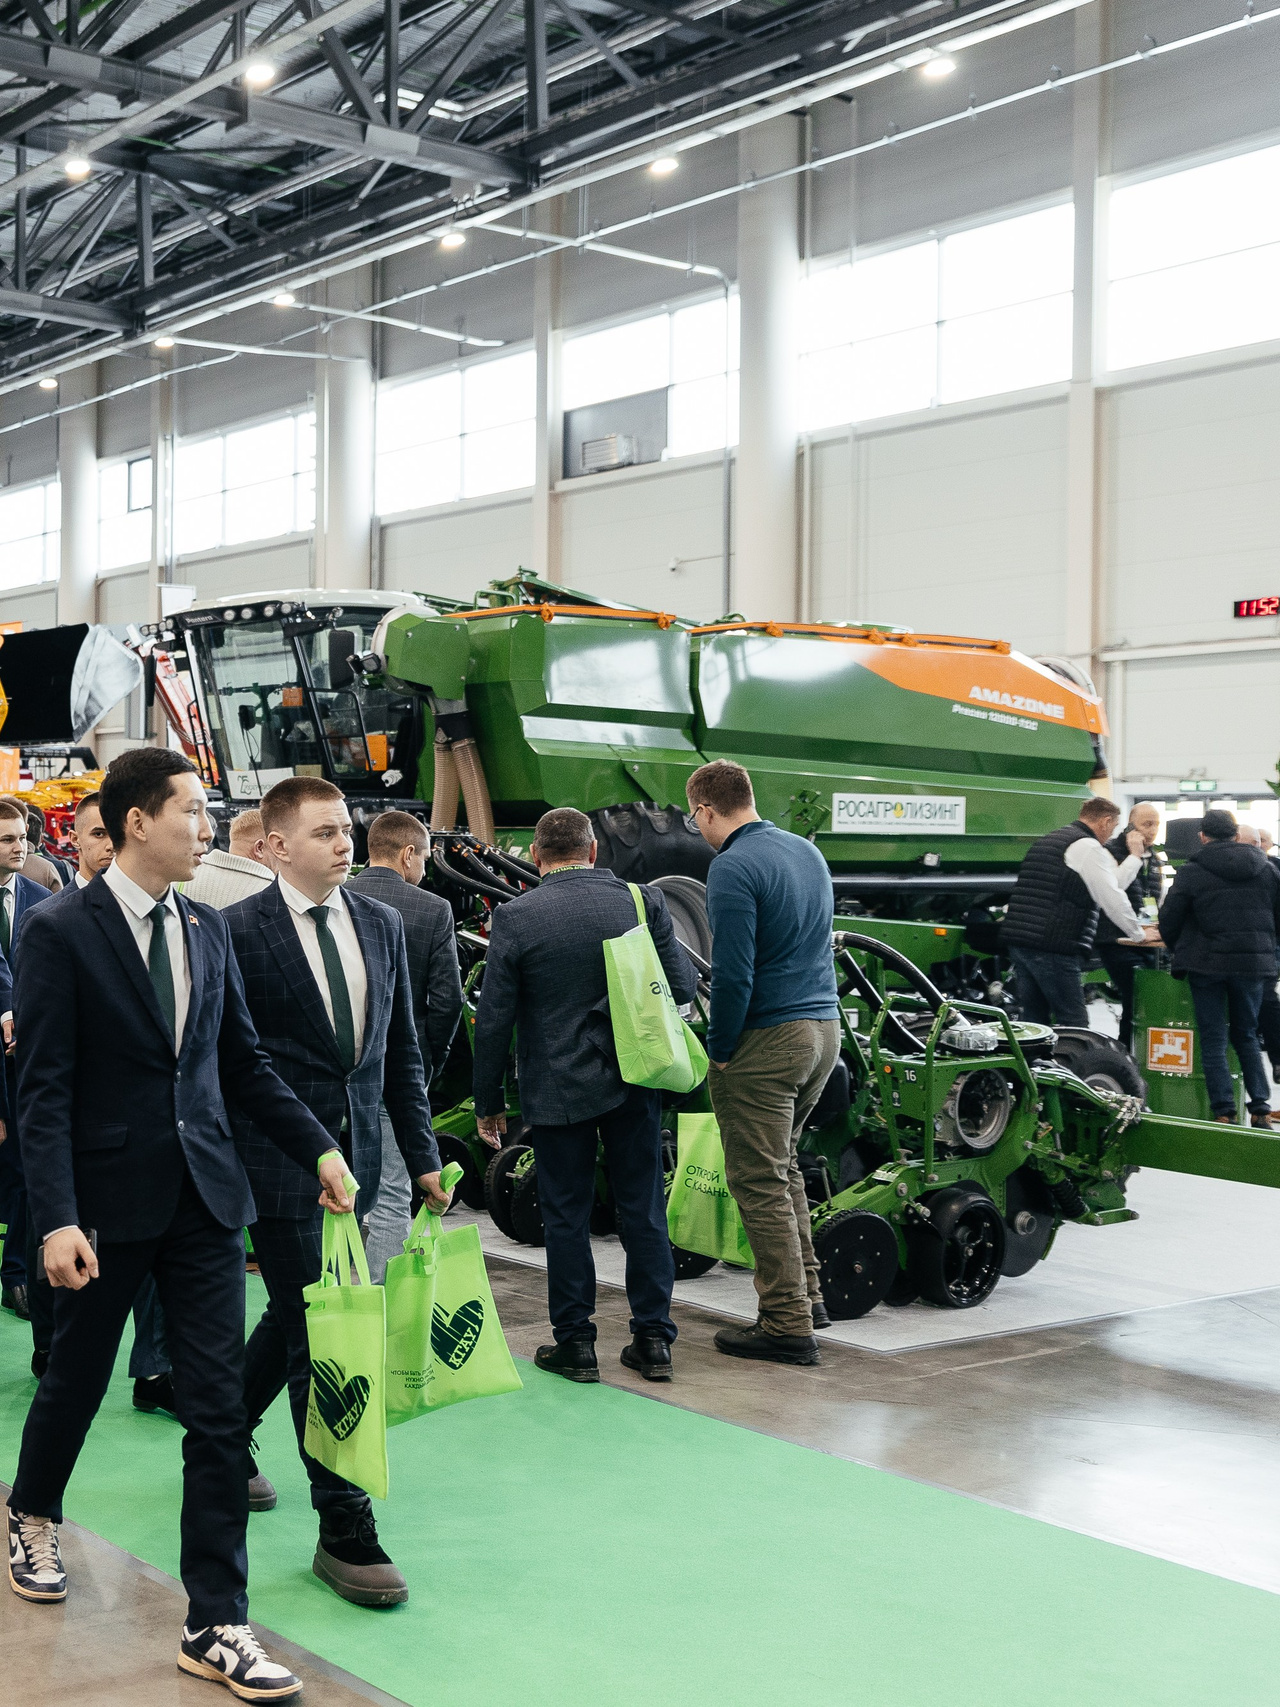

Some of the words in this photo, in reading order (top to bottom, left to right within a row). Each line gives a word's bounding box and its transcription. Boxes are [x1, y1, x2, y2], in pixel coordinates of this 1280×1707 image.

[968, 685, 1065, 719] AMAZONE
[904, 1069, 917, 1082] 16
[686, 1165, 720, 1183] ОТКРОЙ
[448, 1327, 477, 1368] КГАУ
[333, 1402, 360, 1439] КГАУ
